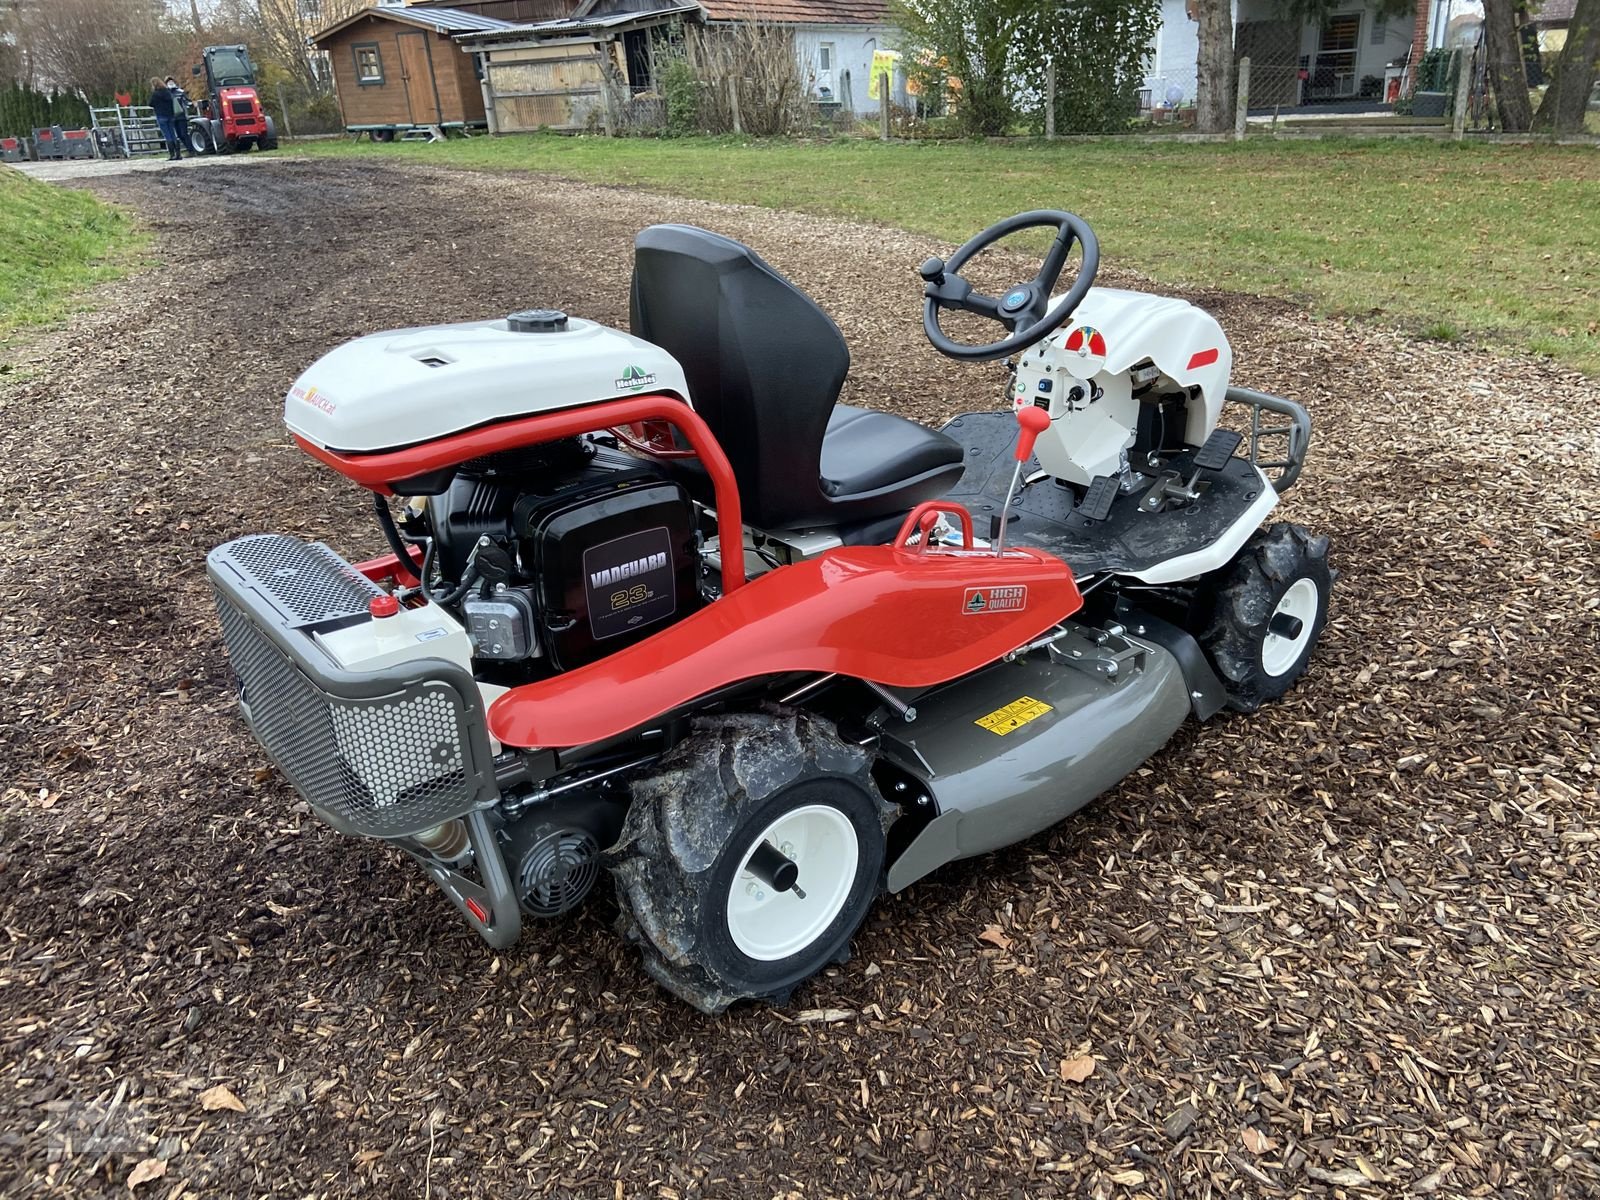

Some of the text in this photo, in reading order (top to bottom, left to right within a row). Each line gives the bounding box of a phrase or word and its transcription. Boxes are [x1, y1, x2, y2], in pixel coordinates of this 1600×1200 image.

[616, 375, 656, 389] Herkules
[591, 552, 667, 589] VANGUARD
[611, 584, 648, 610] 23
[990, 588, 1023, 598] HIGH
[988, 598, 1021, 610] QUALITY
